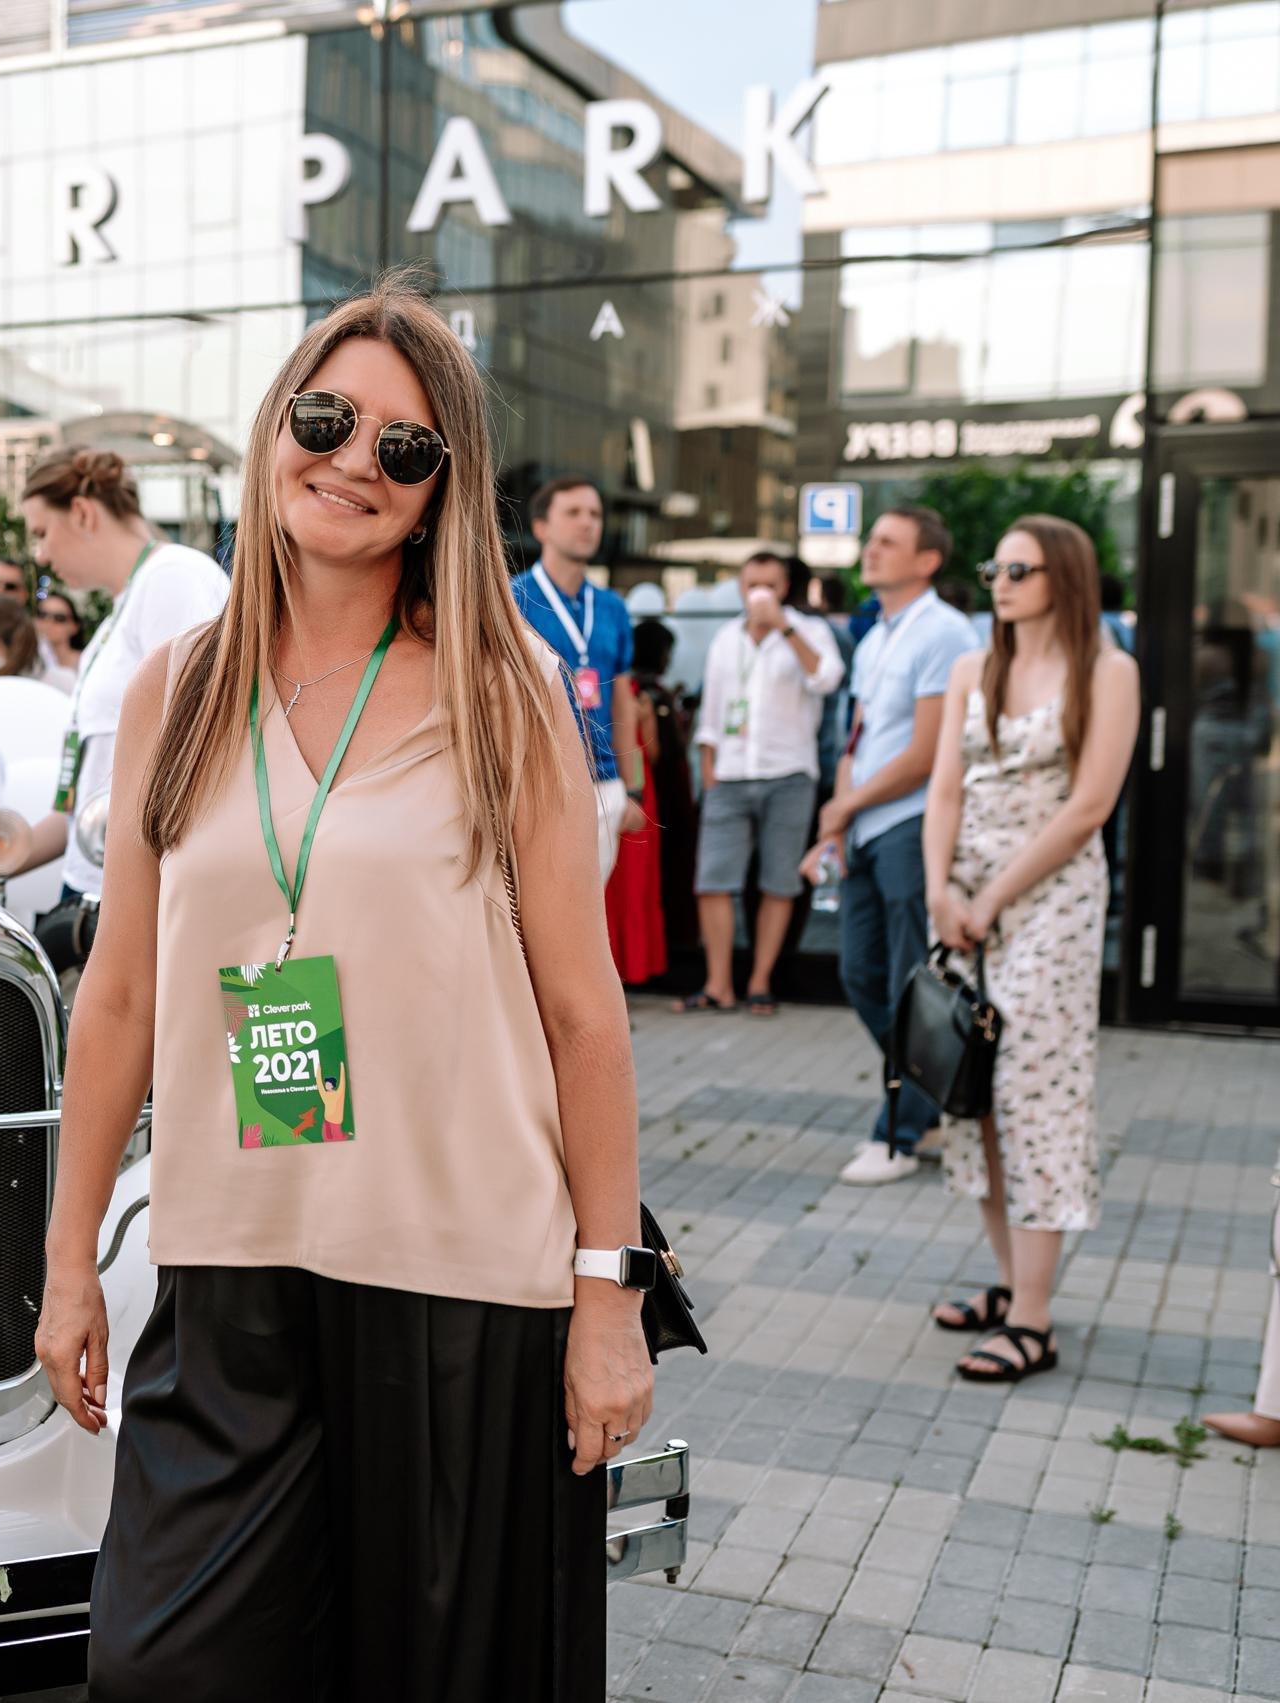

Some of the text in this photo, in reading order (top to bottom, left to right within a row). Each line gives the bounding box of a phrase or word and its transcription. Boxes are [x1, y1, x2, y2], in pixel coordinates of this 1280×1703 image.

[286, 77, 832, 243] PARK
[263, 1001, 312, 1014] Clever park
[250, 1020, 317, 1049] ЛЕТО
[252, 1049, 320, 1083] 2021
